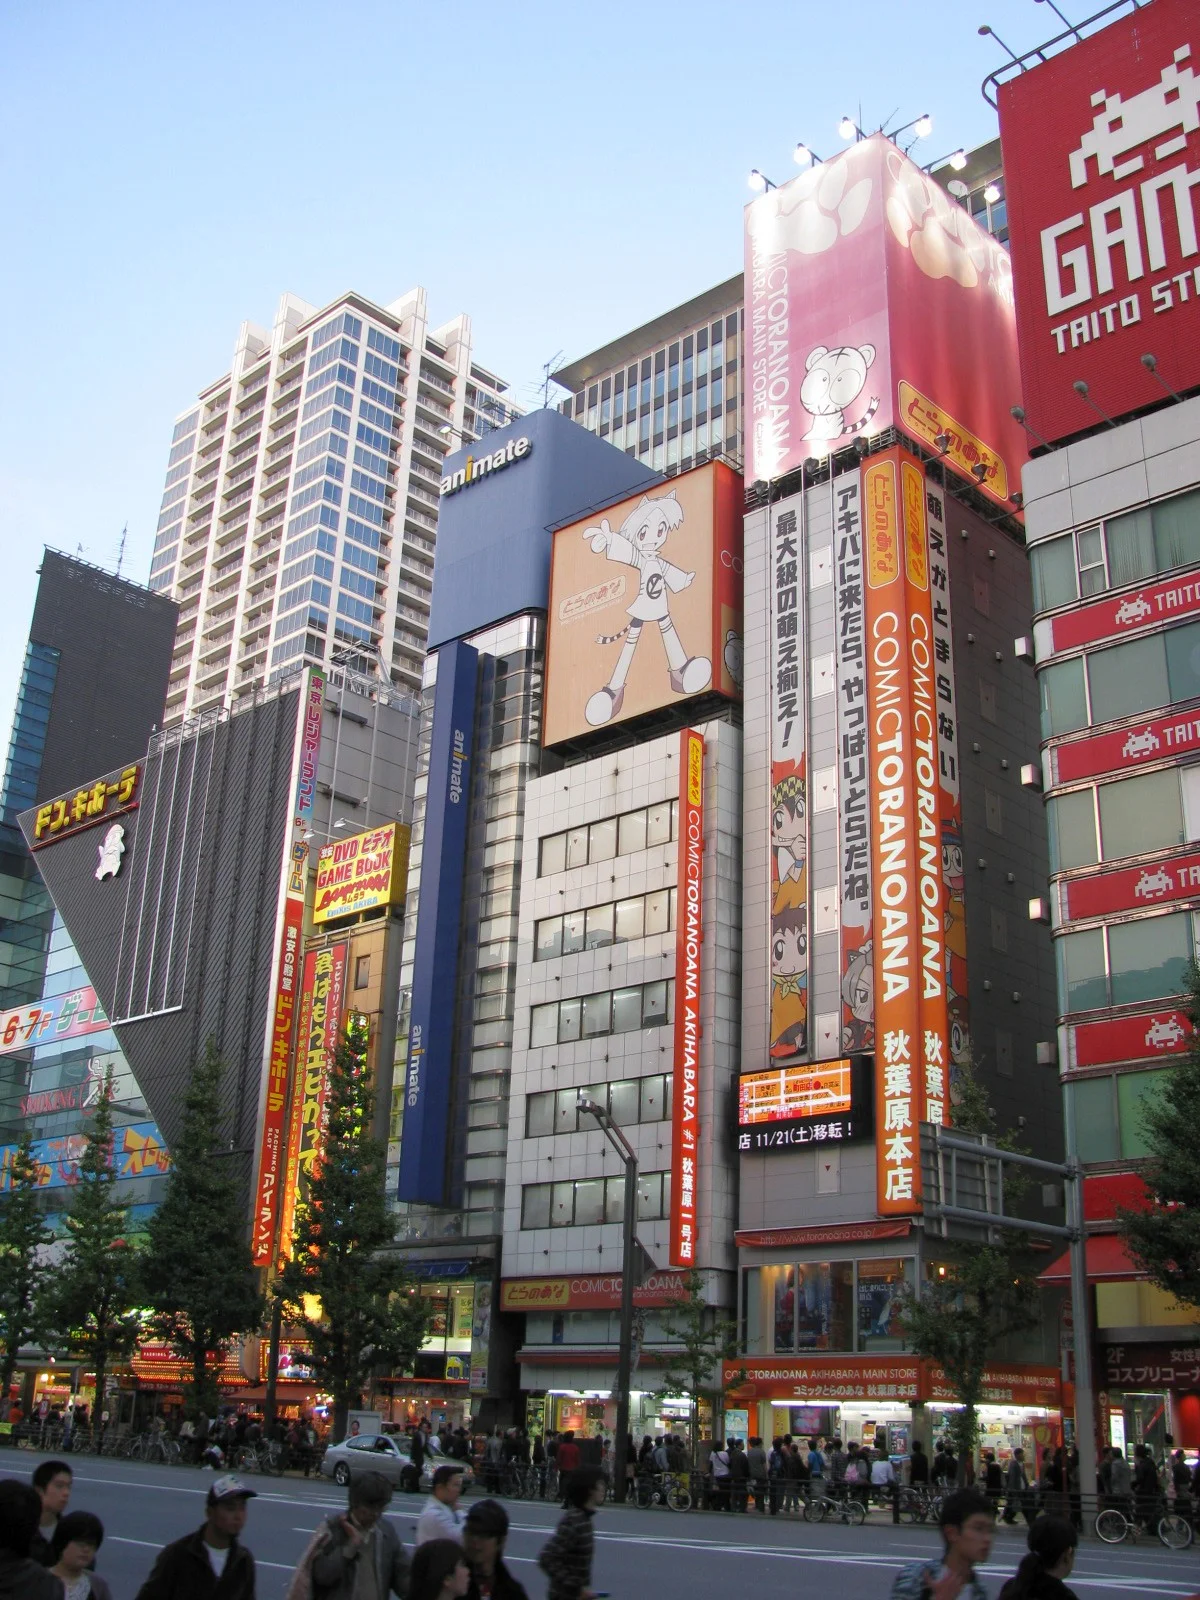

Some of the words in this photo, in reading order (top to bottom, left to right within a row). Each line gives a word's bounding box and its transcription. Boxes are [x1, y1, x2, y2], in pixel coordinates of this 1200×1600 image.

[753, 306, 766, 356] MAIN
[1051, 293, 1141, 354] TAITO
[752, 359, 767, 414] STORE
[439, 437, 532, 496] animate
[873, 473, 894, 574] とらのあな
[908, 471, 924, 582] とらのあな
[450, 729, 467, 805] animate
[872, 611, 910, 1003] COMICTORANOANA
[910, 613, 942, 1000] COMICTORANOANA
[289, 841, 309, 894] ゲーム
[317, 862, 352, 890] GAME
[355, 849, 392, 877] BOOK
[333, 839, 360, 864] DVD
[360, 828, 394, 854] ビデオ
[684, 809, 700, 1000] COMICTORANOANA
[408, 1024, 425, 1108] animate
[682, 1006, 697, 1122] AKIHABARA
[738, 1133, 751, 1149] 店
[882, 1029, 914, 1202] 秋葉原本店
[270, 1128, 280, 1172] PACHINKO
[257, 1172, 275, 1258] アイランド
[680, 1156, 694, 1259] 秋葉原一号店
[507, 1284, 565, 1301] とらのあな
[724, 1369, 808, 1380] COICTORANOANA
[810, 1369, 860, 1379] AKIHABARA
[862, 1368, 888, 1379] MAIN
[889, 1368, 917, 1379] STORE
[1107, 1347, 1125, 1364] 2F
[793, 1384, 864, 1397] コミックとらのあな
[866, 1384, 917, 1397] 秋葉原本店
